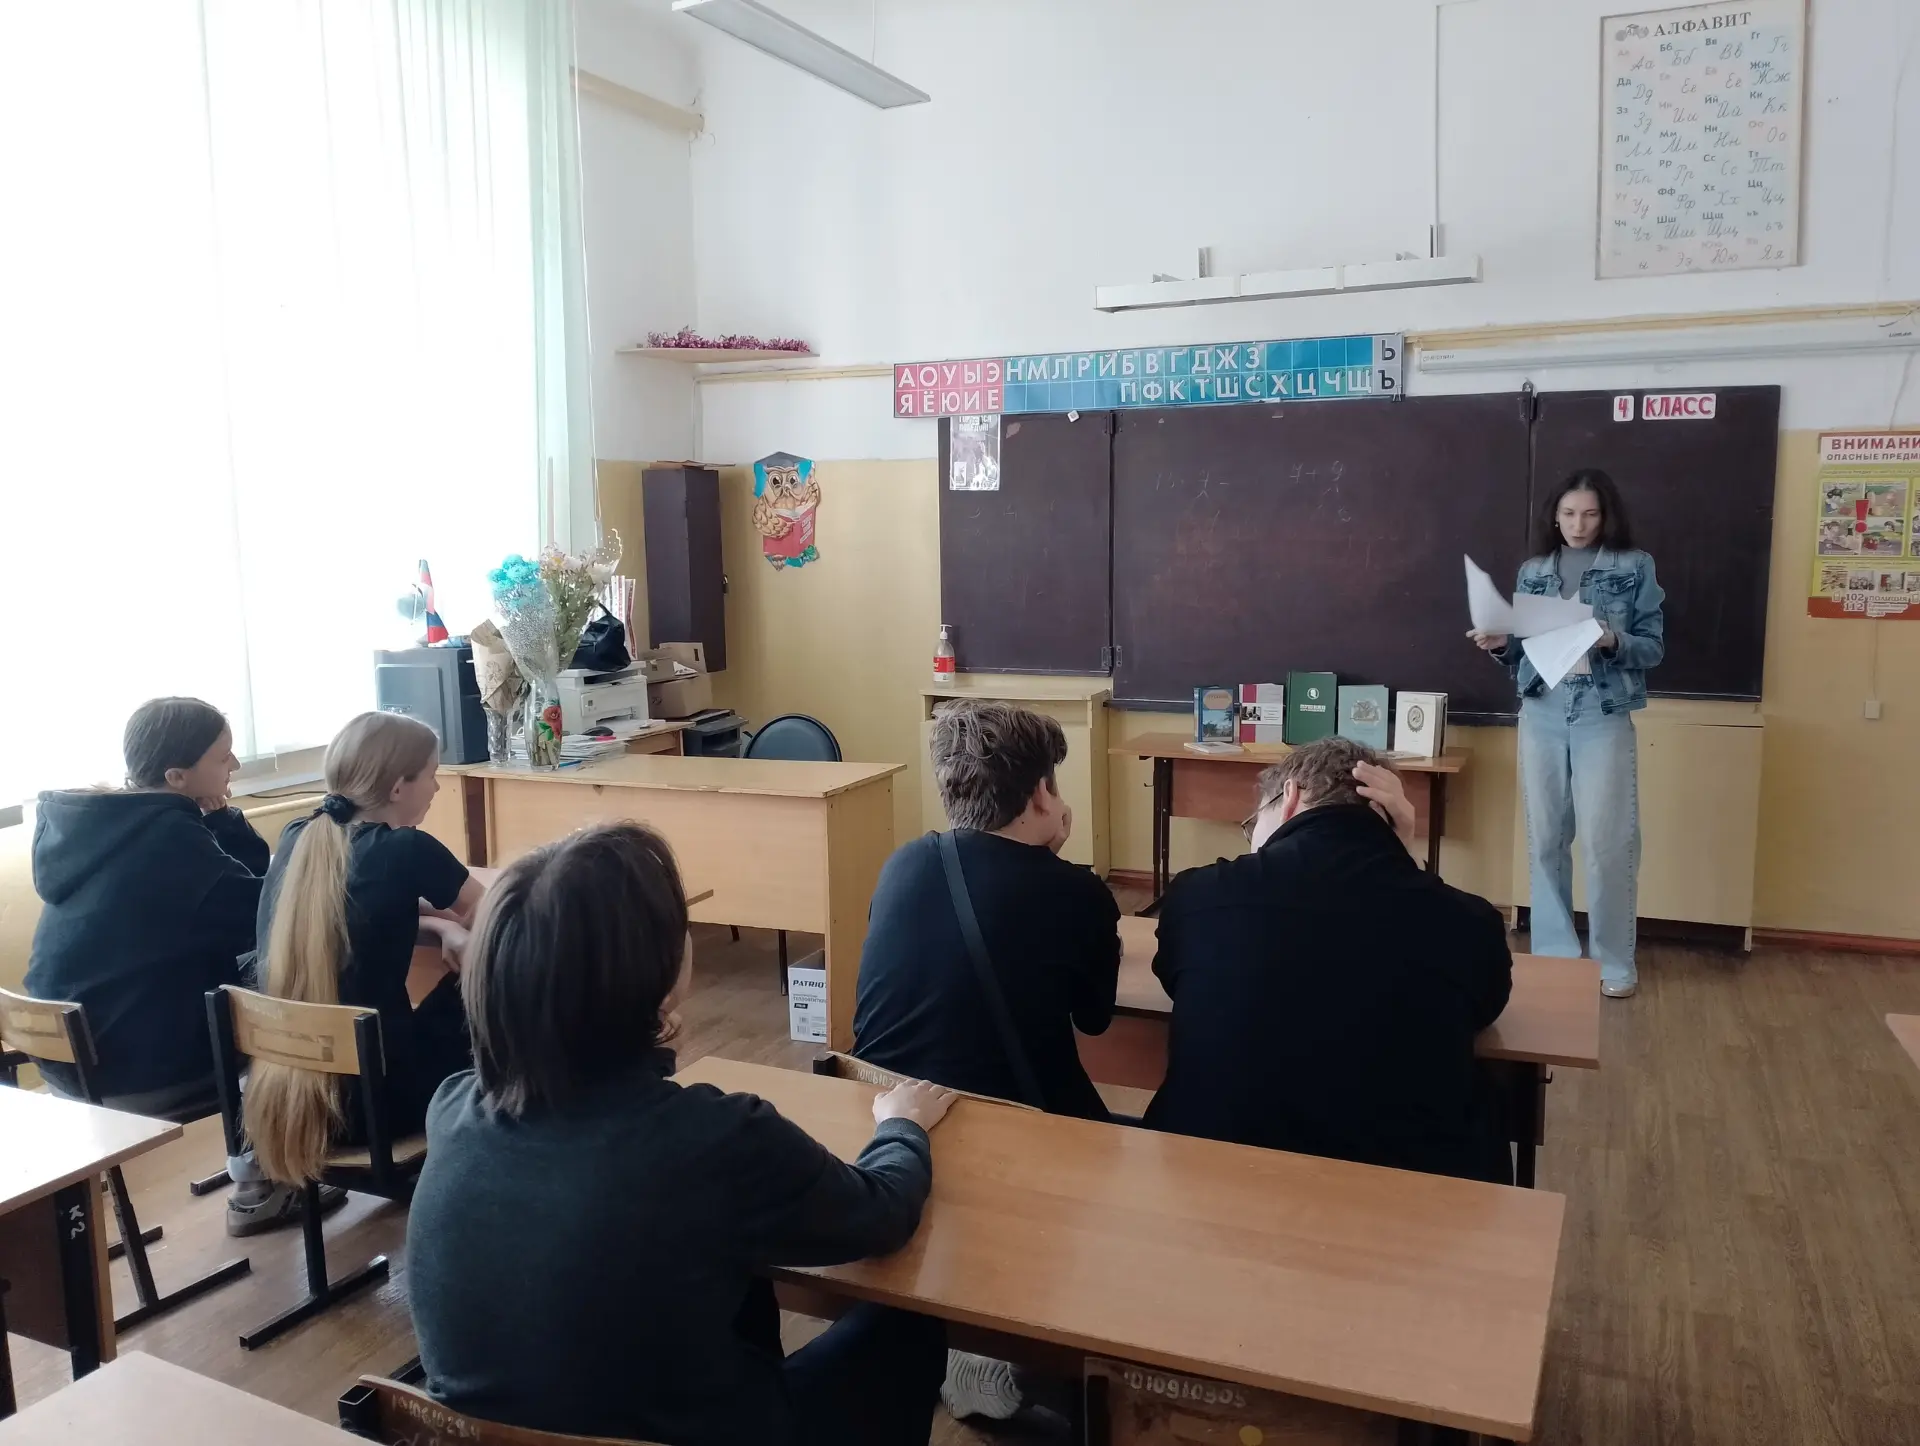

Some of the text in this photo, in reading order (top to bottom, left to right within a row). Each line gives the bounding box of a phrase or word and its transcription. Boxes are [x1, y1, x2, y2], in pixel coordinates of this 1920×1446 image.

[1654, 11, 1751, 37] АЛФАВИТ
[1619, 396, 1712, 418] 4 КЛАСС
[1882, 453, 1920, 461] ПРЕДМ
[793, 980, 826, 988] PATRIO
